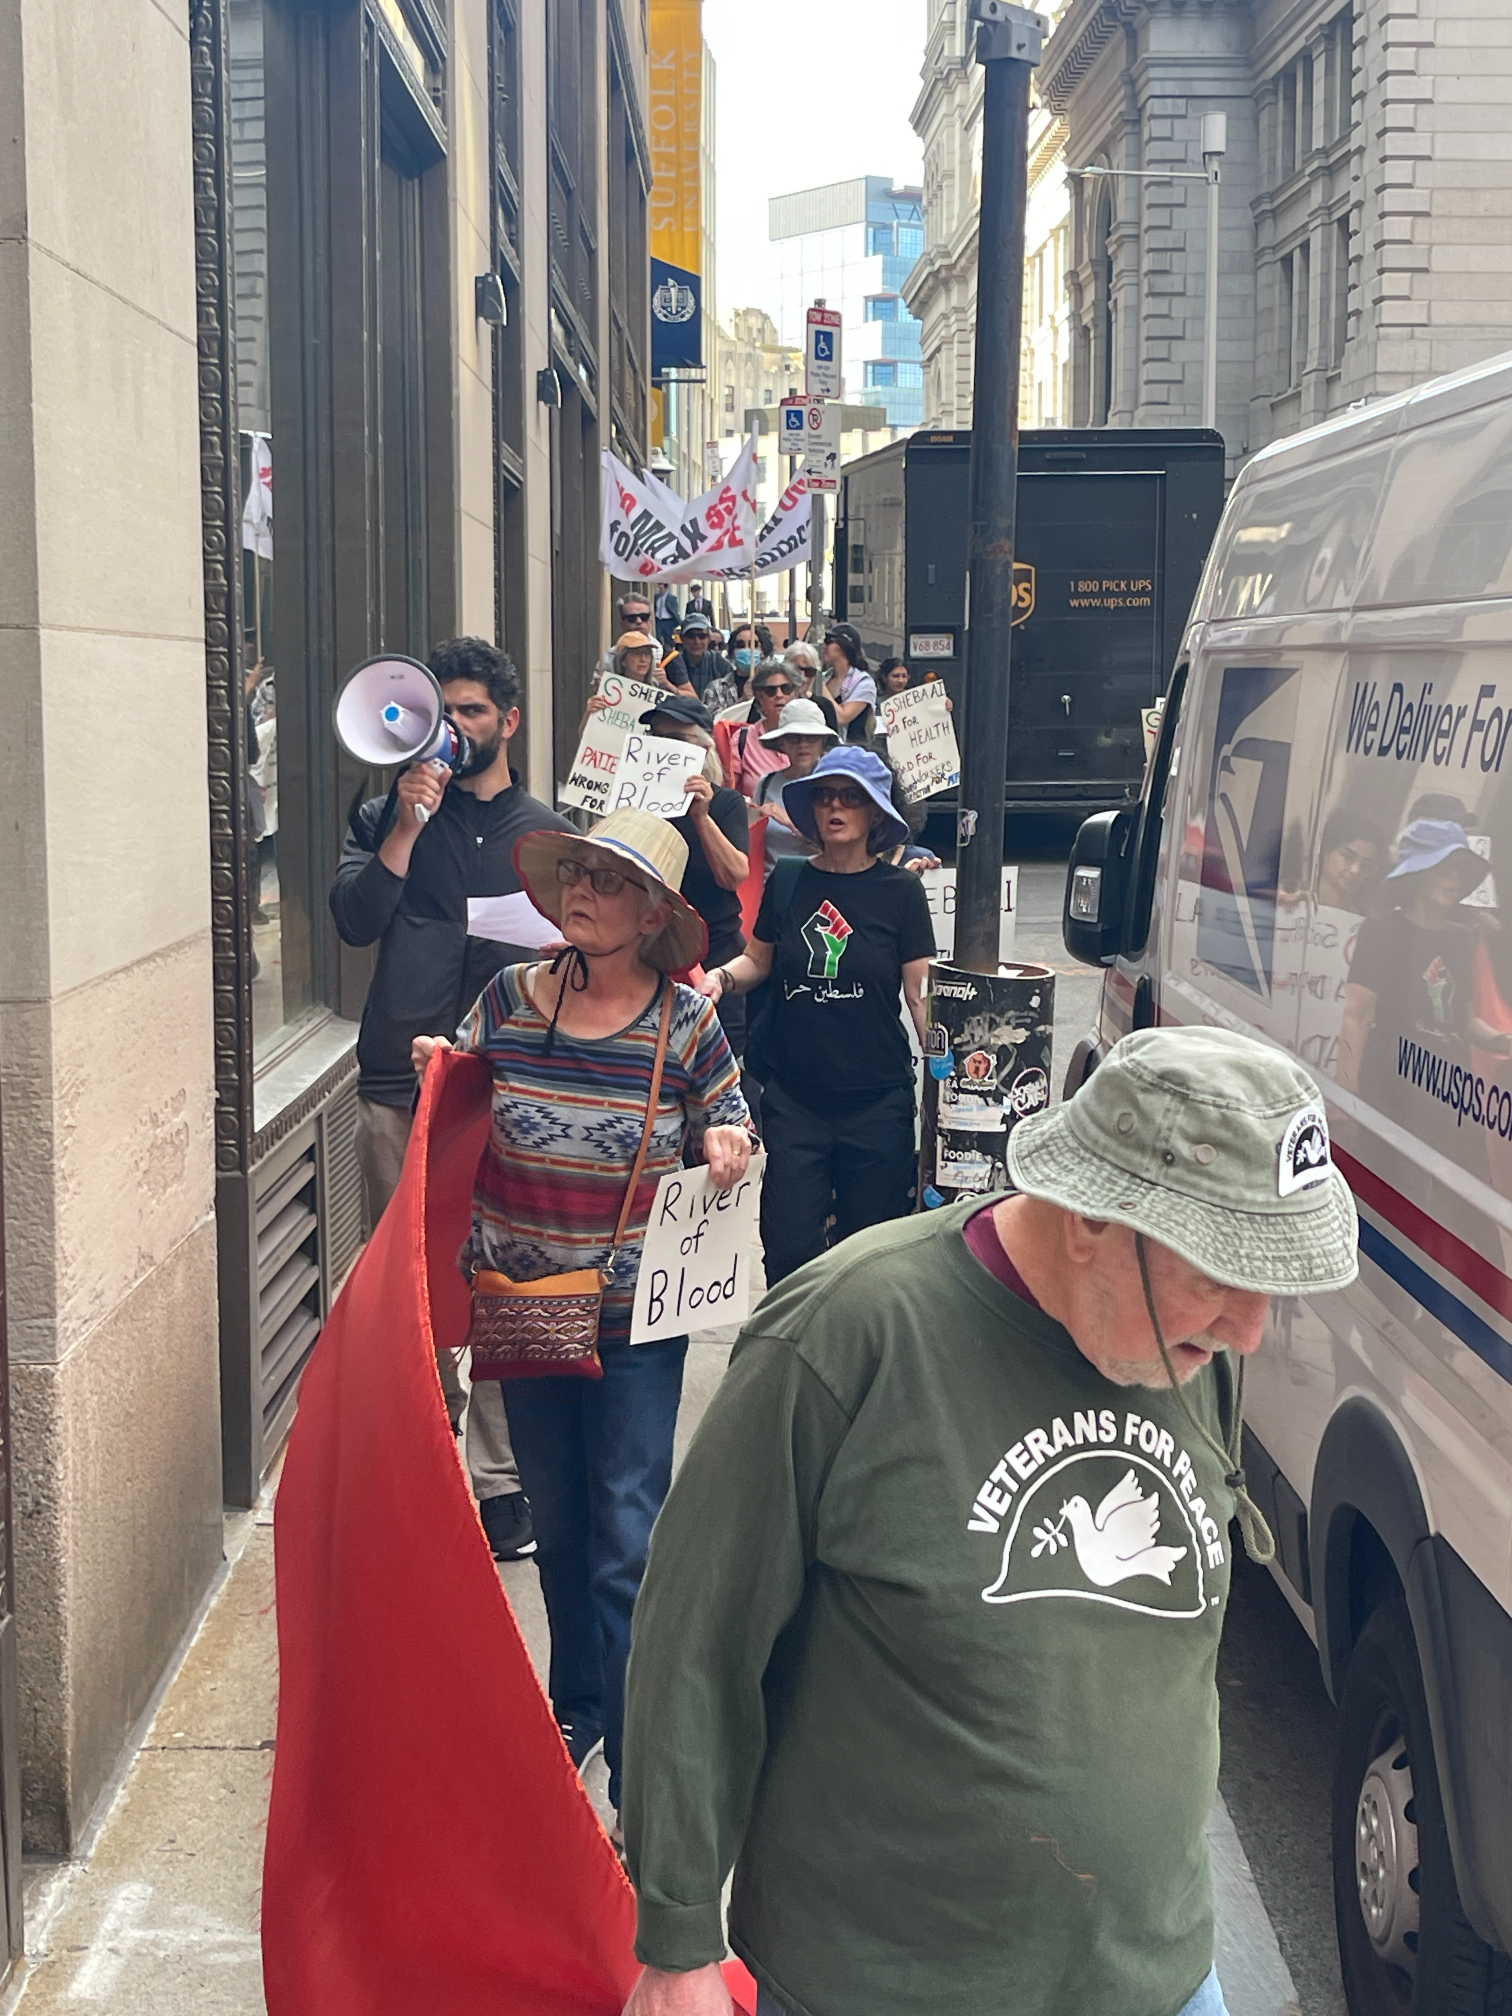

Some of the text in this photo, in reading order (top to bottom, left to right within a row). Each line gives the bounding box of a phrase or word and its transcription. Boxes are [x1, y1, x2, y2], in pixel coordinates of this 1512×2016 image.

[650, 49, 677, 232] SUFFOLK
[683, 50, 700, 232] UNIVERSITY
[1078, 580, 1100, 592] 800
[1102, 580, 1128, 592] PICK
[1130, 579, 1153, 592] UPS
[1069, 596, 1152, 610] www.ups.com
[629, 684, 667, 705] SHEB
[893, 688, 928, 713] SHEBA
[930, 681, 947, 699] AI
[597, 706, 636, 734] SHEBA
[902, 716, 919, 730] FOR
[1346, 681, 1512, 773] We Deliver For
[908, 721, 951, 749] HEALTH
[580, 746, 620, 775] PATIE
[626, 737, 697, 768] River
[915, 752, 937, 766] FOR
[643, 767, 671, 783] of
[581, 794, 606, 812] FOR
[616, 782, 689, 813] Blood
[943, 1150, 984, 1161] FOODIE
[659, 1181, 751, 1227] River
[680, 1218, 709, 1256] of
[647, 1252, 738, 1326] Blood
[967, 1409, 1225, 1570] VETERANS FOR PEACE
